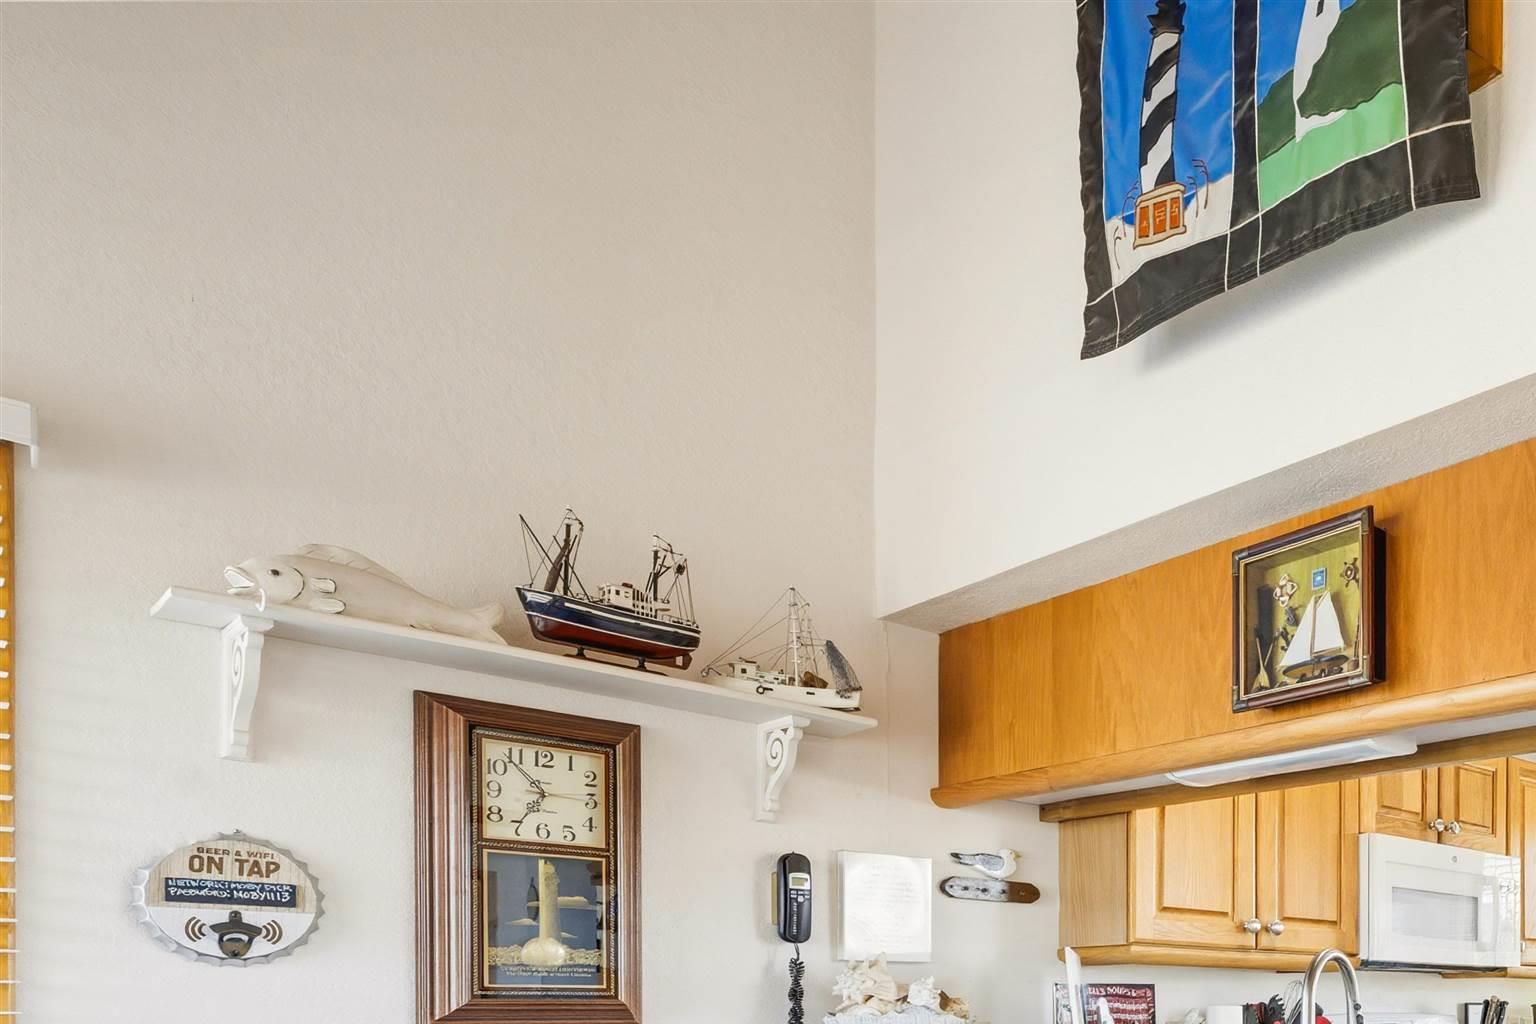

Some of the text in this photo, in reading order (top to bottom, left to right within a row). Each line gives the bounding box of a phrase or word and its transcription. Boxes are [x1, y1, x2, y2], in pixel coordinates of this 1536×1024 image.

[508, 747, 523, 765] 11
[534, 750, 554, 768] 12
[568, 755, 573, 771] 1
[487, 758, 507, 776] 10
[584, 770, 598, 788] 2
[487, 780, 501, 798] 9
[585, 793, 598, 809] 3
[487, 805, 503, 823] 8
[511, 819, 523, 837] 7
[536, 822, 551, 840] 6
[582, 816, 597, 832] 4
[563, 825, 576, 842] 5
[197, 847, 275, 859] BEER & WIFI
[188, 854, 280, 878] ON TAP
